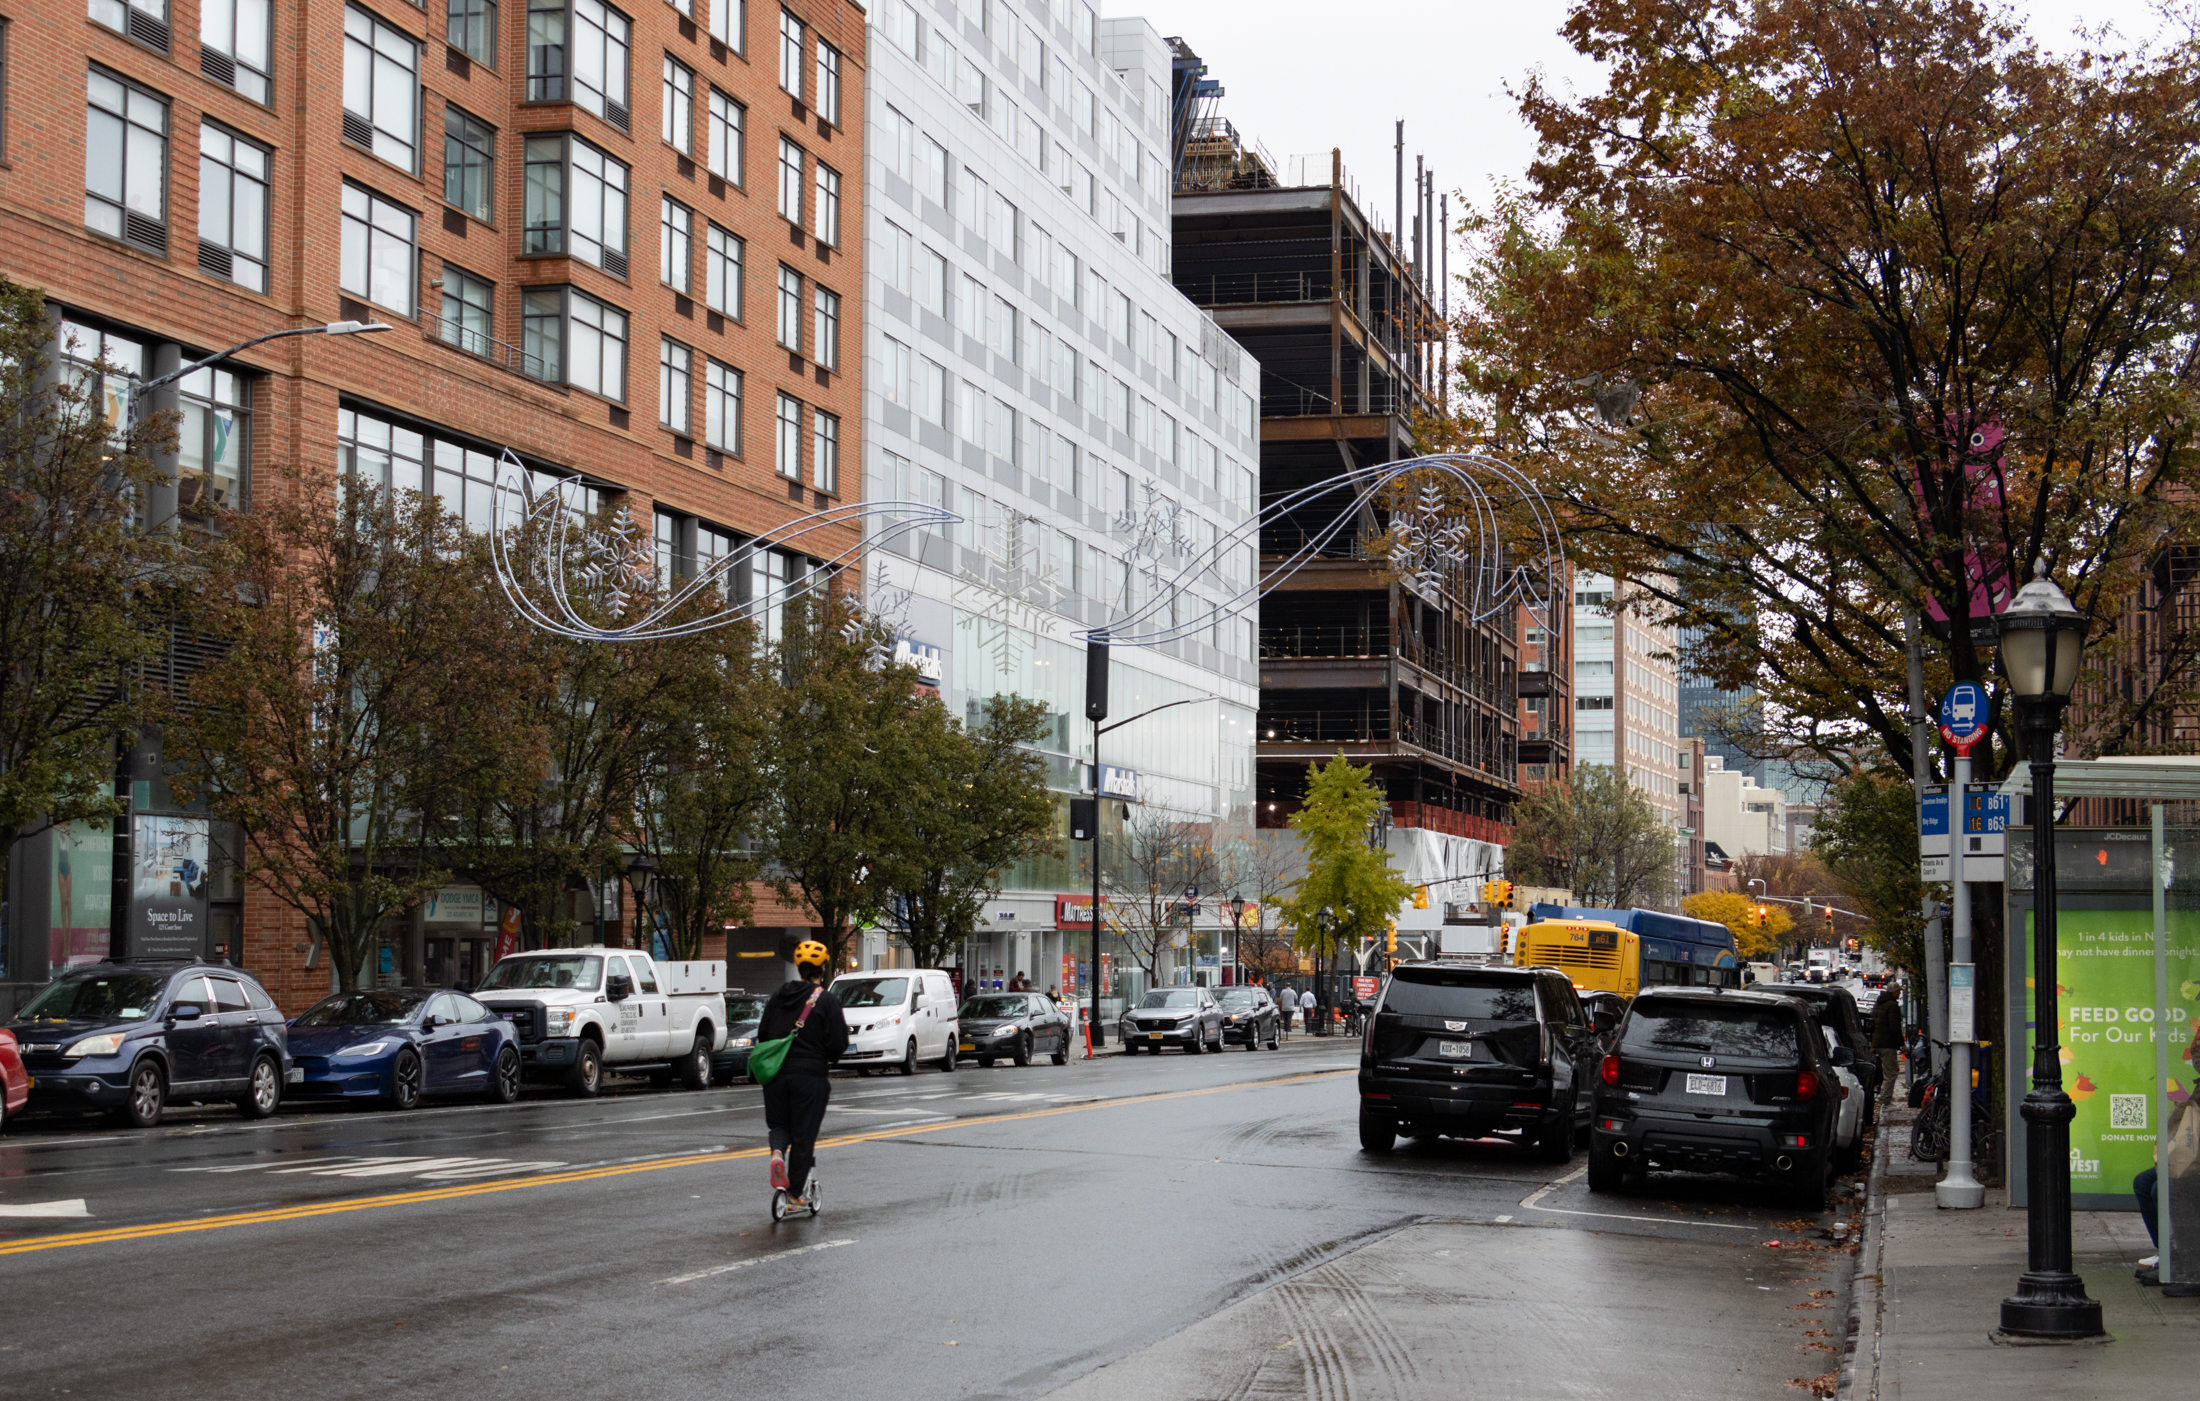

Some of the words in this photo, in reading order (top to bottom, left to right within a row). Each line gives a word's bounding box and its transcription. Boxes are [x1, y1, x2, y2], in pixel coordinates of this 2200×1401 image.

[1943, 727, 1953, 739] NO
[1952, 727, 1983, 744] STANDING
[1103, 767, 1136, 797] Marshalls
[1988, 795, 2004, 810] B61
[1988, 816, 2005, 831] B63
[2103, 832, 2147, 841] JCDecaux
[92, 865, 110, 881] KIDS
[440, 892, 461, 904] DODGE
[463, 892, 479, 904] YMCA
[147, 908, 168, 926] Space
[169, 912, 177, 922] to
[178, 908, 193, 922] Live
[1570, 933, 1584, 941] 764
[1596, 935, 1609, 943] B61
[2078, 932, 2084, 941] 1
[2085, 932, 2096, 941] in
[2098, 932, 2106, 941] 4
[2109, 931, 2129, 942] kids
[2132, 932, 2142, 941] in
[2144, 931, 2171, 942] NC
[2076, 947, 2093, 956] not
[2096, 946, 2120, 956] have
[2122, 946, 2155, 956] dinner
[2164, 946, 2199, 959] onight.
[2070, 1007, 2119, 1023] FEED
[2070, 1026, 2099, 1042] For
[2106, 1026, 2142, 1042] Our
[2149, 1026, 2187, 1042] Kds
[2101, 1134, 2135, 1142] DONATE
[2136, 1134, 2157, 1142] NOW
[2070, 1159, 2099, 1172] VEST
